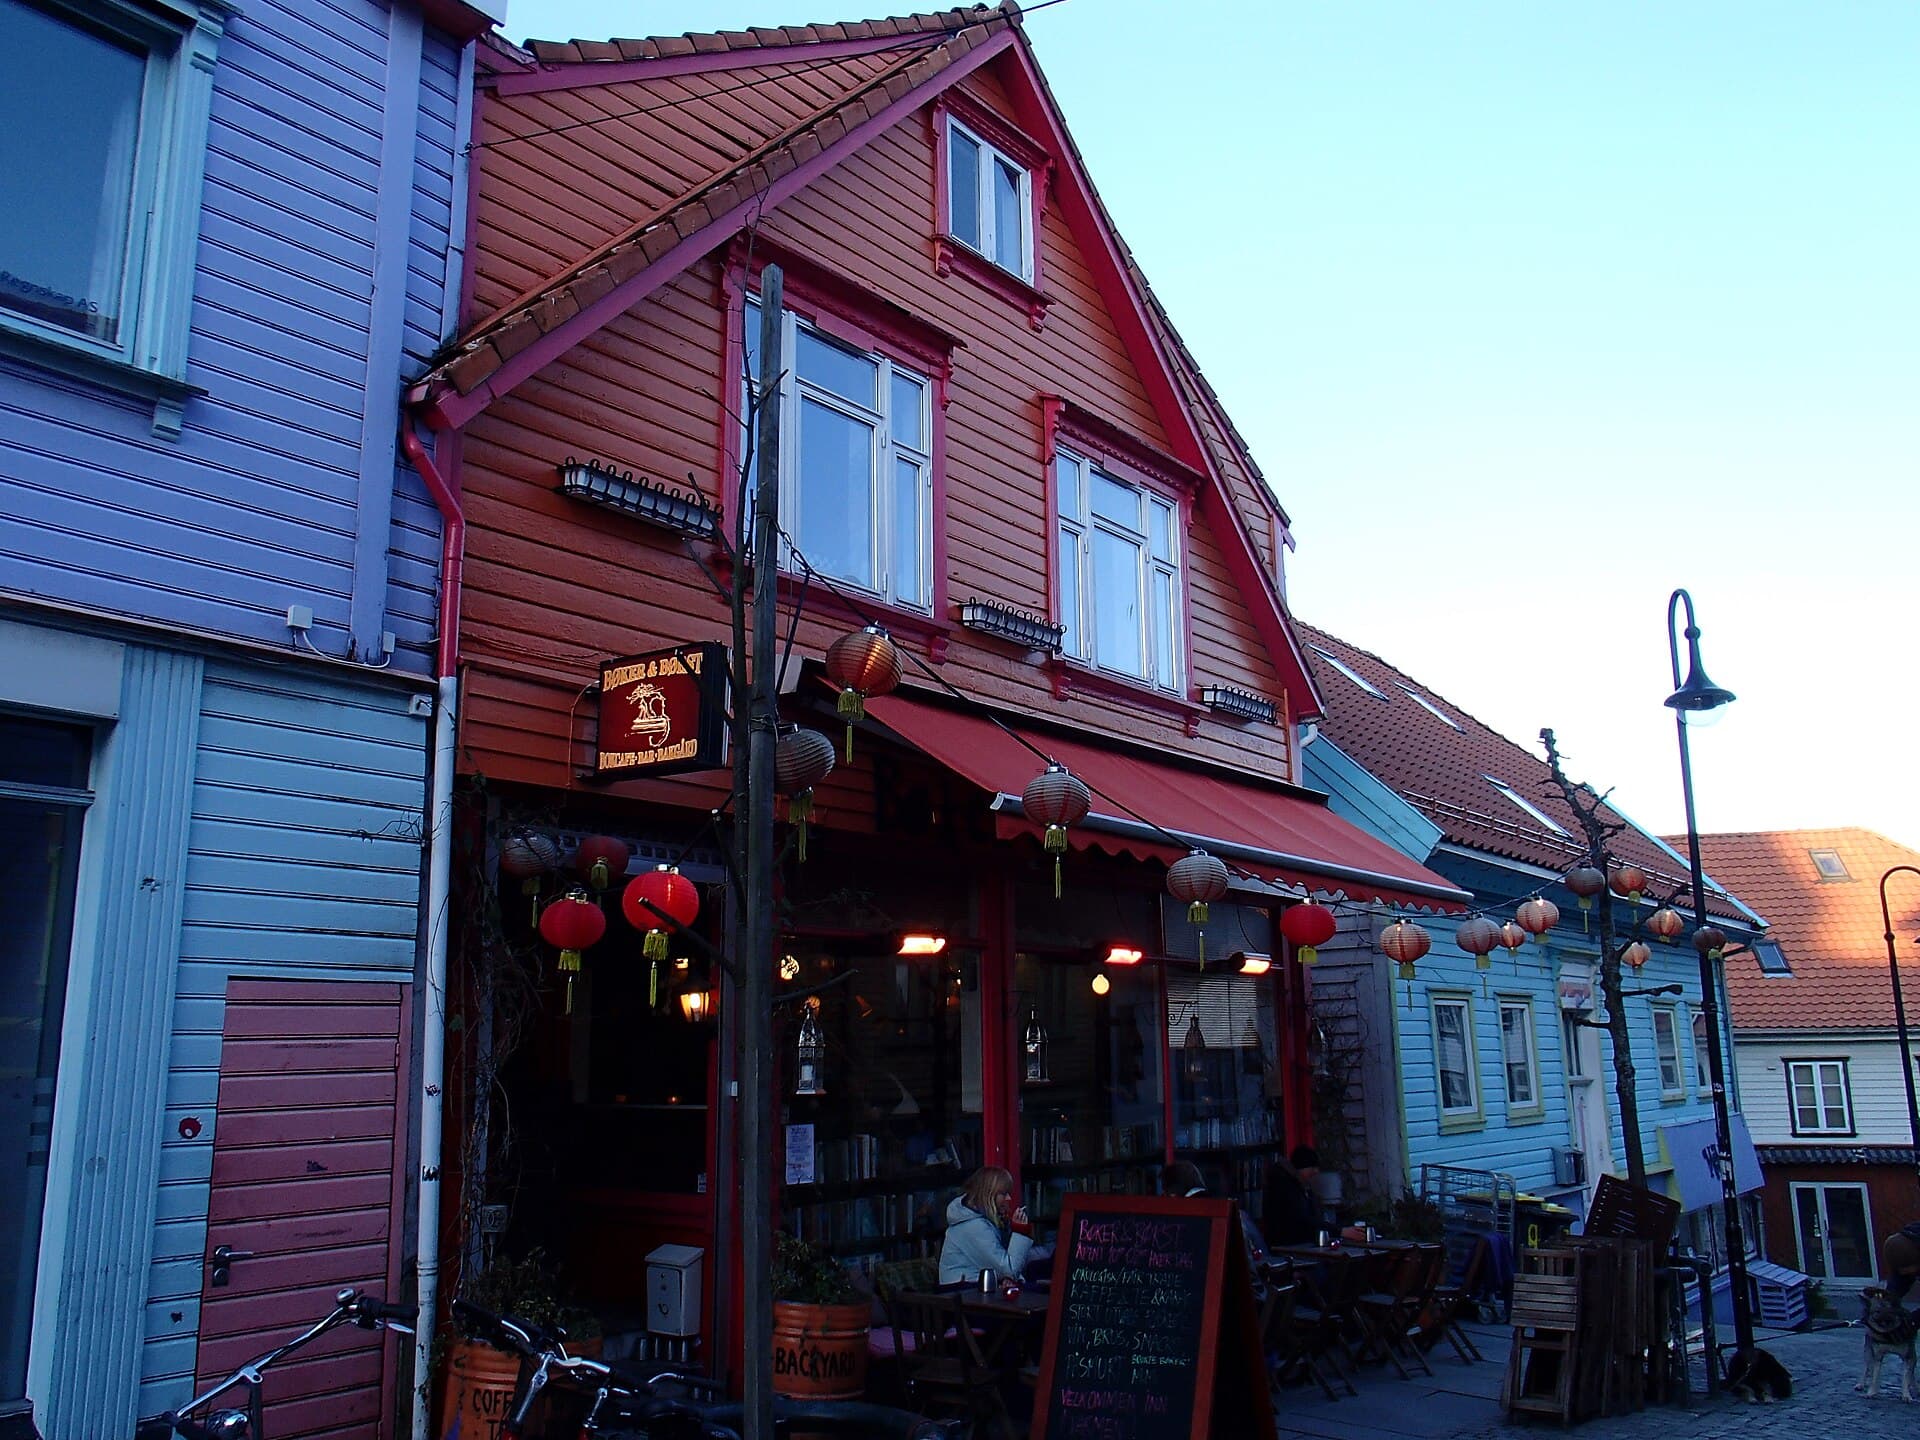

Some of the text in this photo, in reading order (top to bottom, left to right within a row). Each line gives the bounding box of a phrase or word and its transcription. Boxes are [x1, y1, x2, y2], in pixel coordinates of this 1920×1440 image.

[78, 297, 98, 313] AS
[602, 663, 646, 692] BØKER
[646, 660, 658, 678] &
[776, 1347, 857, 1378] BACKYARD
[472, 1389, 514, 1414] COFF
